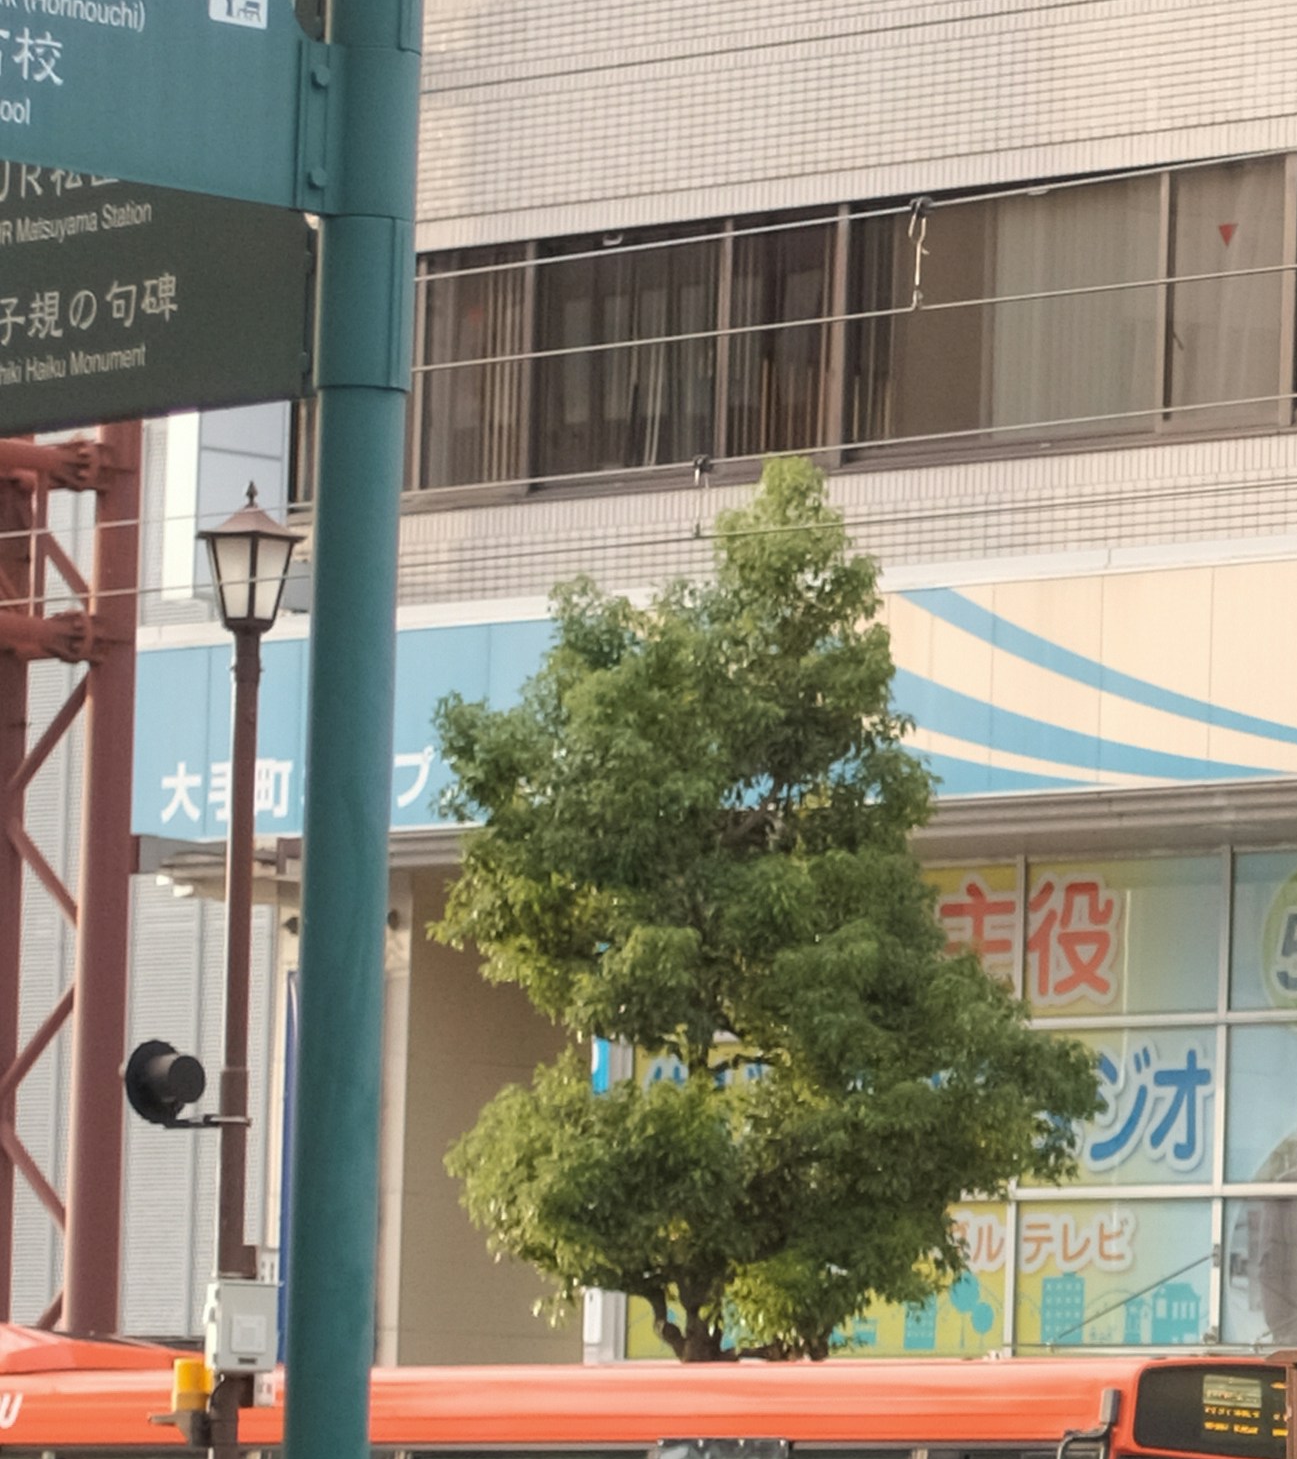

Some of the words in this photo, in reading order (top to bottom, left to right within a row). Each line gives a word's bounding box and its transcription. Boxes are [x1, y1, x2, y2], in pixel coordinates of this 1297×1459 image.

[0, 27, 63, 86] 校
[16, 212, 98, 243] Matsuyama
[101, 201, 152, 230] Station
[0, 272, 178, 346] 子規の句碑
[25, 357, 66, 383] Haiku
[70, 343, 147, 378] Monument
